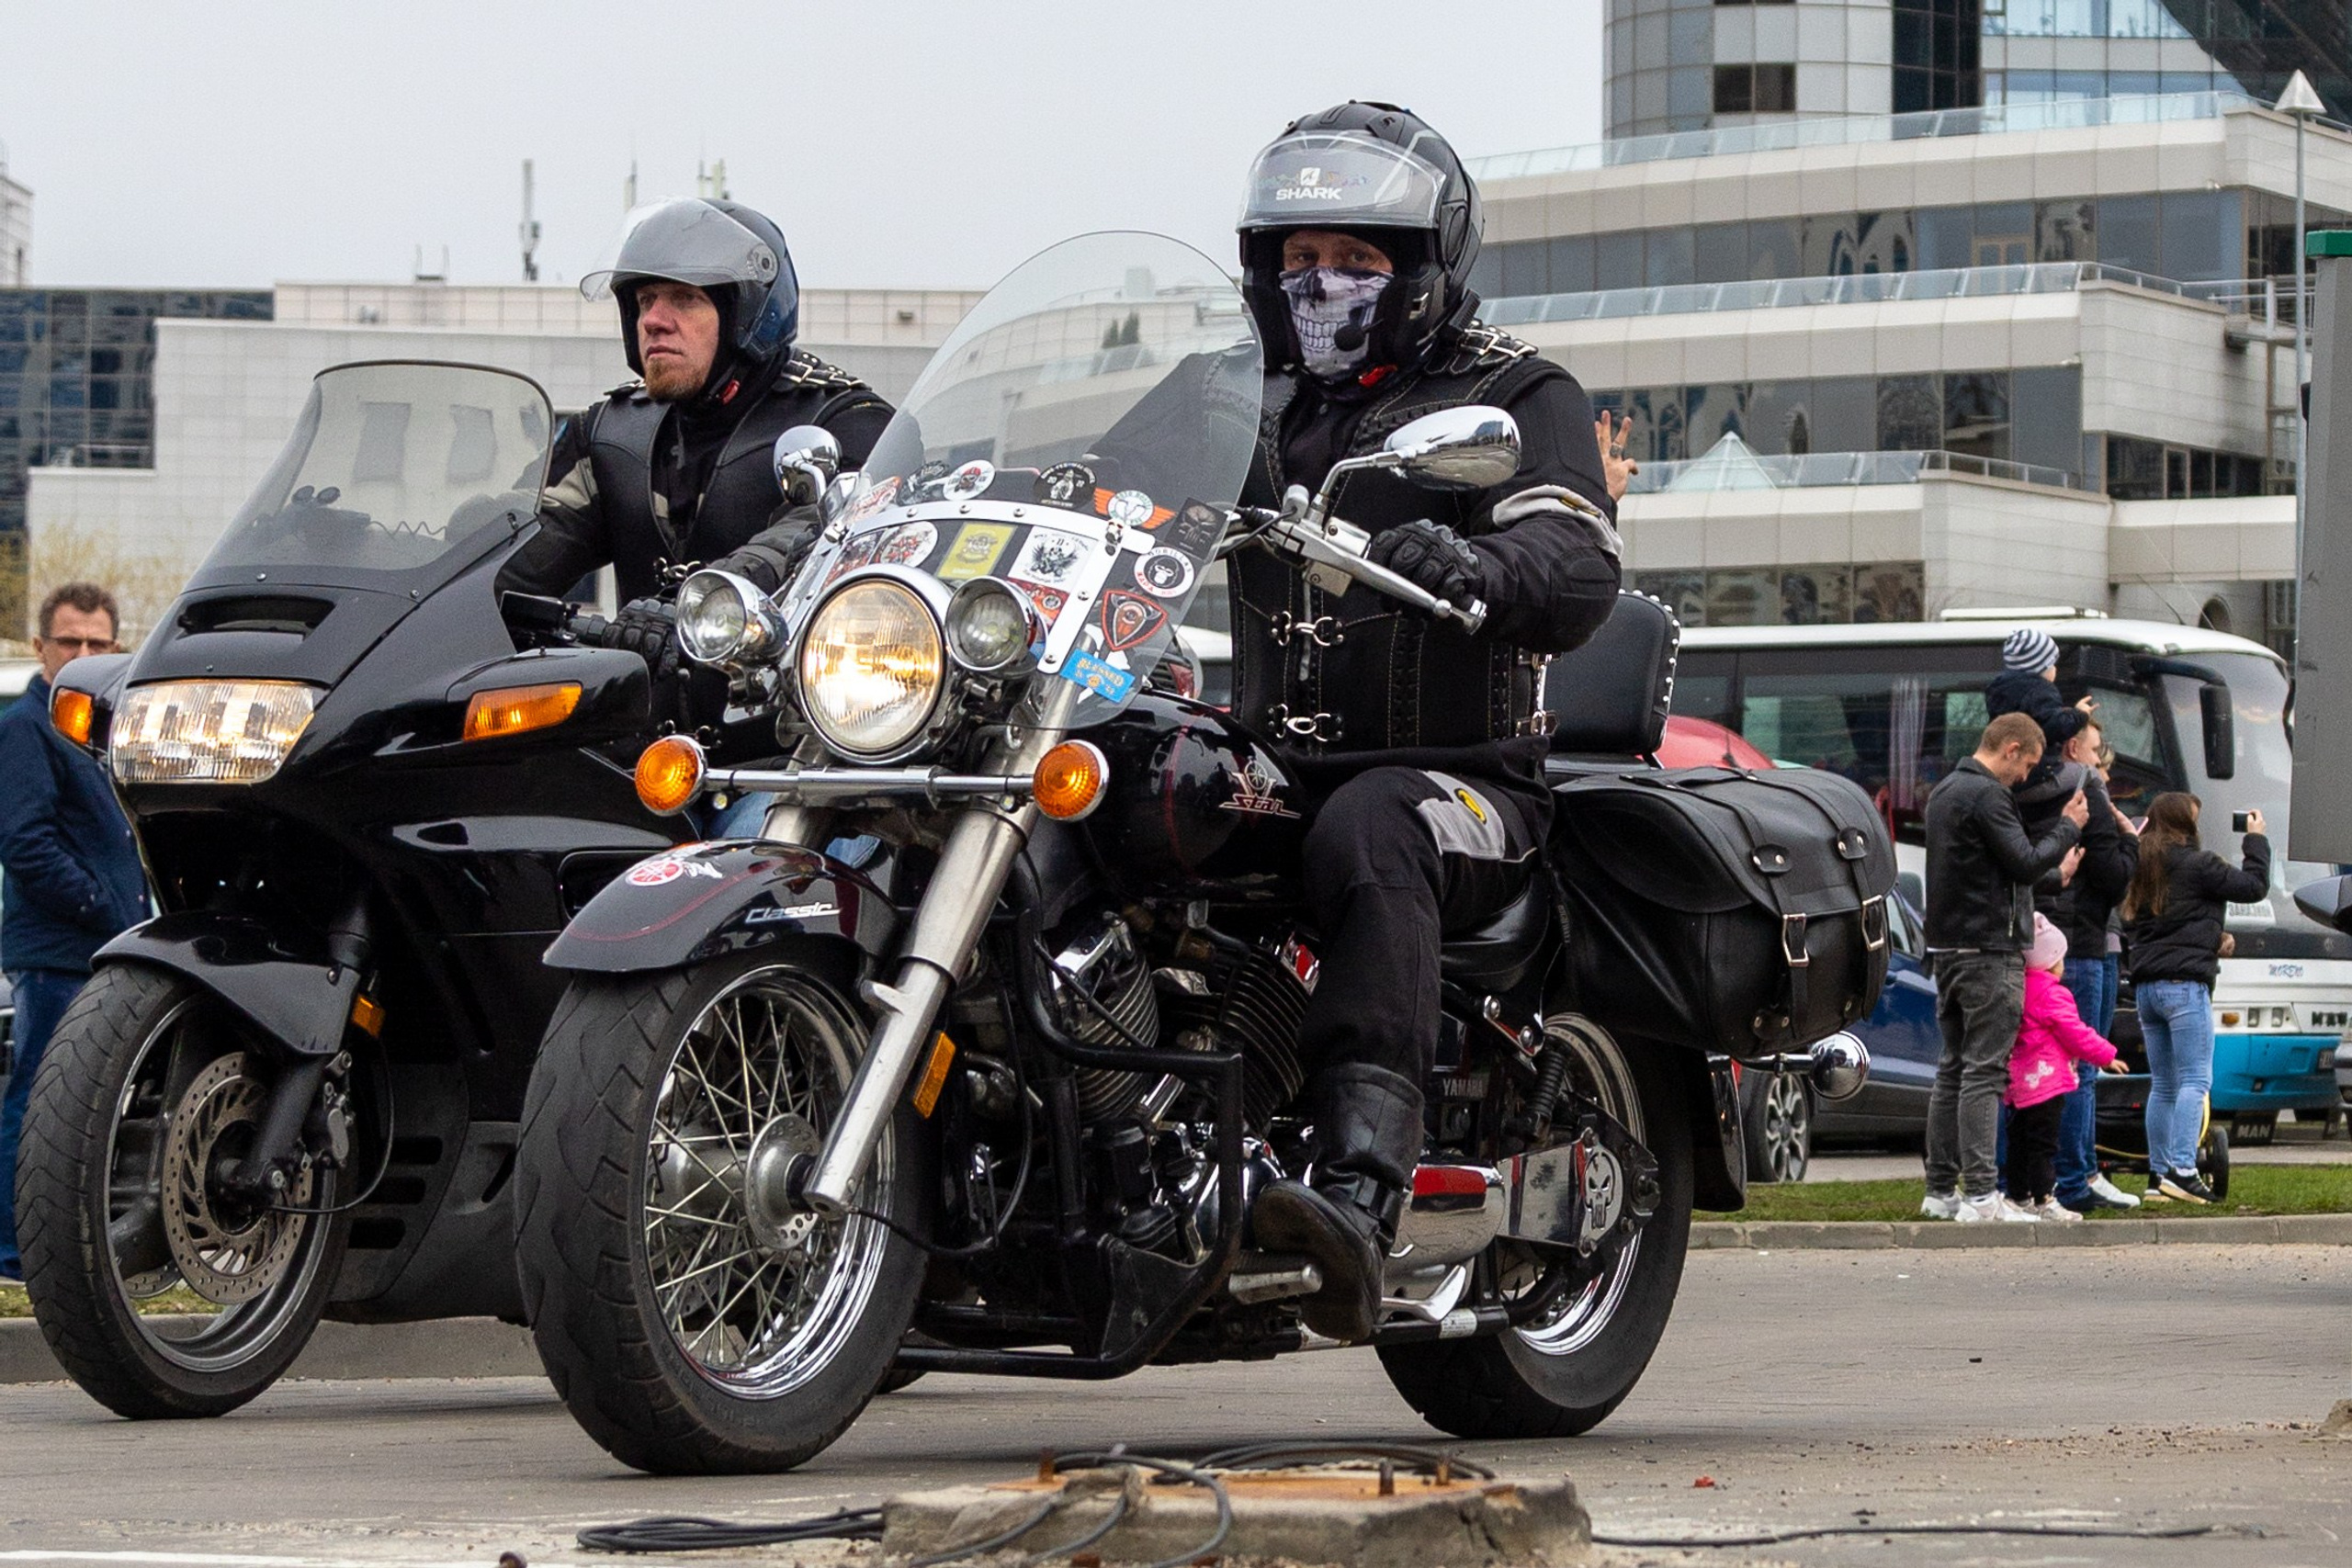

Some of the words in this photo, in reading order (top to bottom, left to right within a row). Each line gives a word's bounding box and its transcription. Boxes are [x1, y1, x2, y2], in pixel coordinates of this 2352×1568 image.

[1275, 186, 1342, 201] SHARK
[744, 902, 842, 924] Classic
[1442, 1078, 1487, 1098] YAMAHA
[2237, 1124, 2271, 1138] MAN
